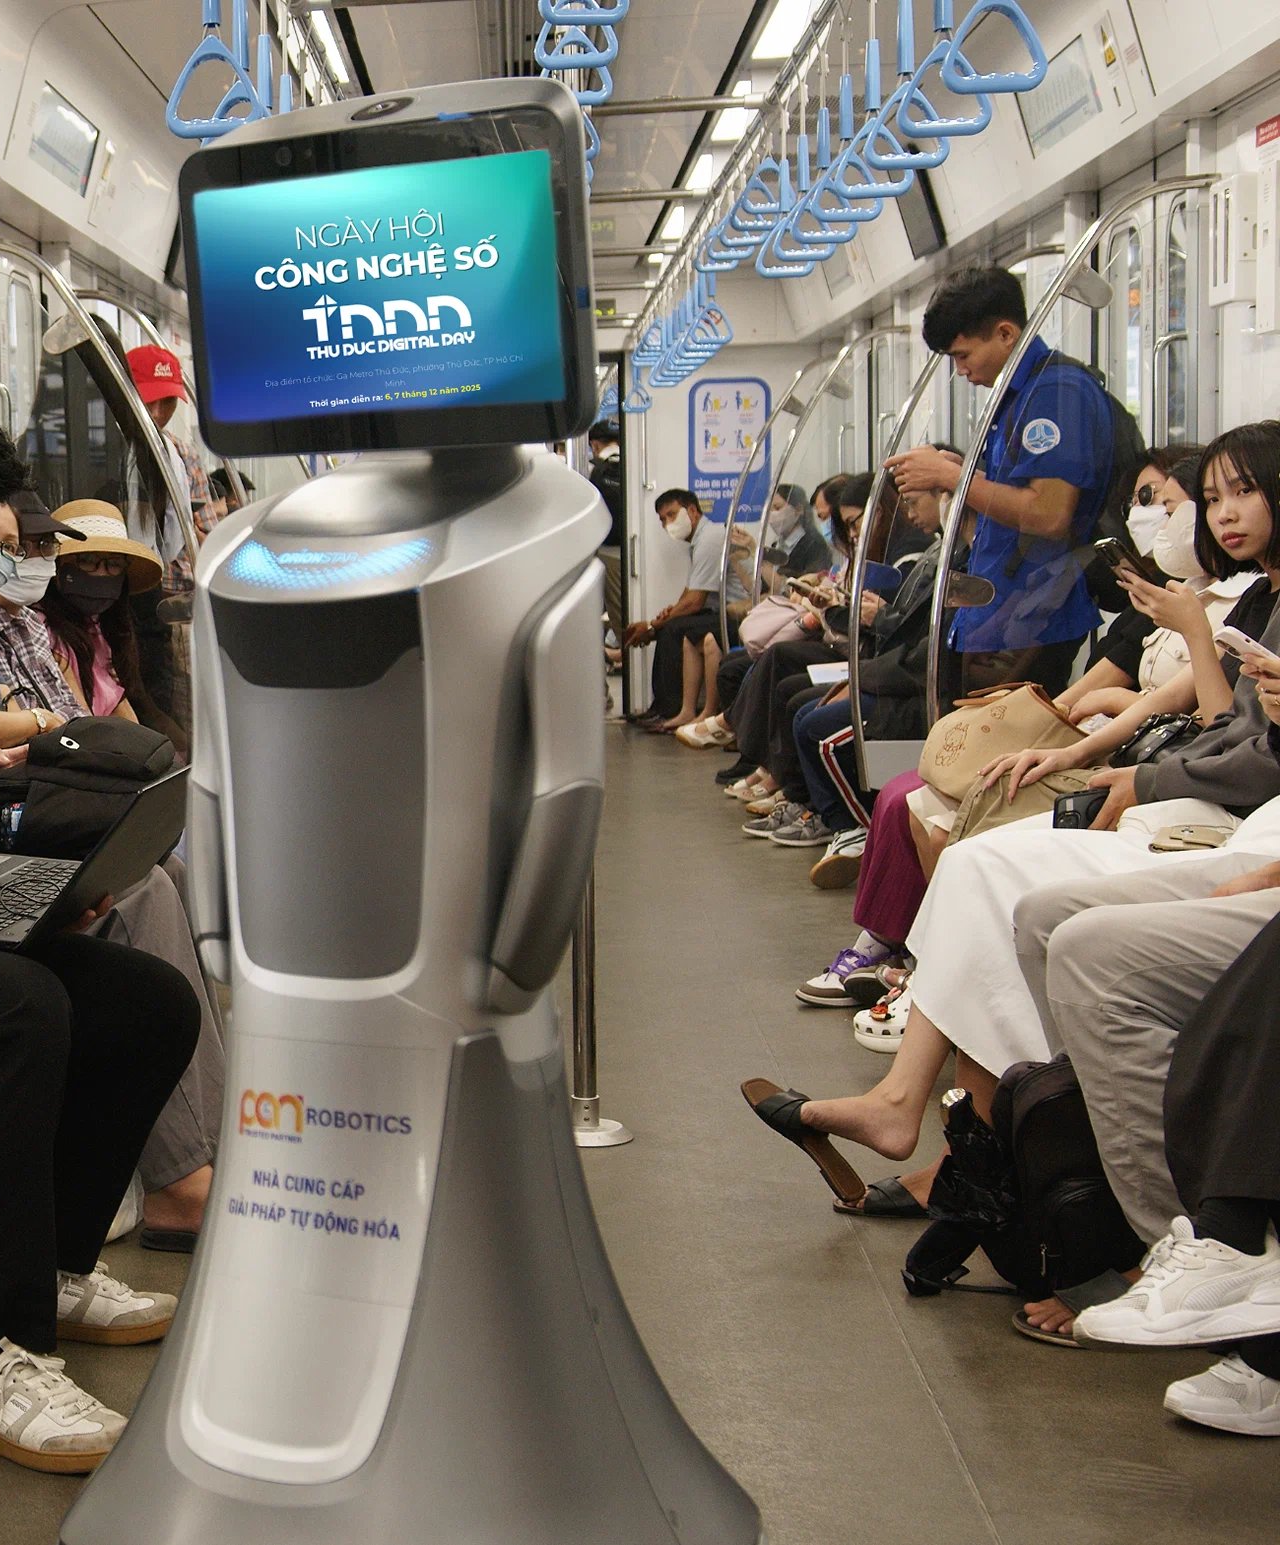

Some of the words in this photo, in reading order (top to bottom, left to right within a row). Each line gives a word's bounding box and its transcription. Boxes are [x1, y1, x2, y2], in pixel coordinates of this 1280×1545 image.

[295, 215, 381, 250] NGÀY
[389, 208, 444, 243] HỘI
[254, 257, 349, 290] CÔNG
[356, 242, 448, 281] NGHỆ
[454, 234, 500, 271] SỐ
[306, 344, 340, 360] THU
[343, 341, 376, 357] DUC
[377, 334, 440, 353] DIGITAL
[441, 330, 476, 347] DAY
[349, 369, 374, 379] Metro
[484, 357, 496, 365] TP
[310, 398, 329, 408] Thời
[330, 398, 350, 408] gian
[351, 394, 371, 404] diễn
[372, 394, 384, 402] ra:
[394, 391, 400, 399] 7
[401, 388, 428, 398] tháng
[429, 387, 438, 396] 12
[439, 386, 459, 395] năm
[460, 383, 481, 393] 2025
[384, 379, 407, 388] Minh
[306, 1107, 413, 1135] ROBOTICS
[253, 1169, 280, 1190] NHÀ
[285, 1174, 326, 1197] CUNG
[330, 1178, 365, 1201] CẤP
[228, 1195, 249, 1217] GIẢI
[251, 1202, 286, 1223] PHÁP
[290, 1208, 312, 1232] TỰ
[314, 1207, 359, 1236] ĐỘNG
[363, 1215, 401, 1241] HÓA
